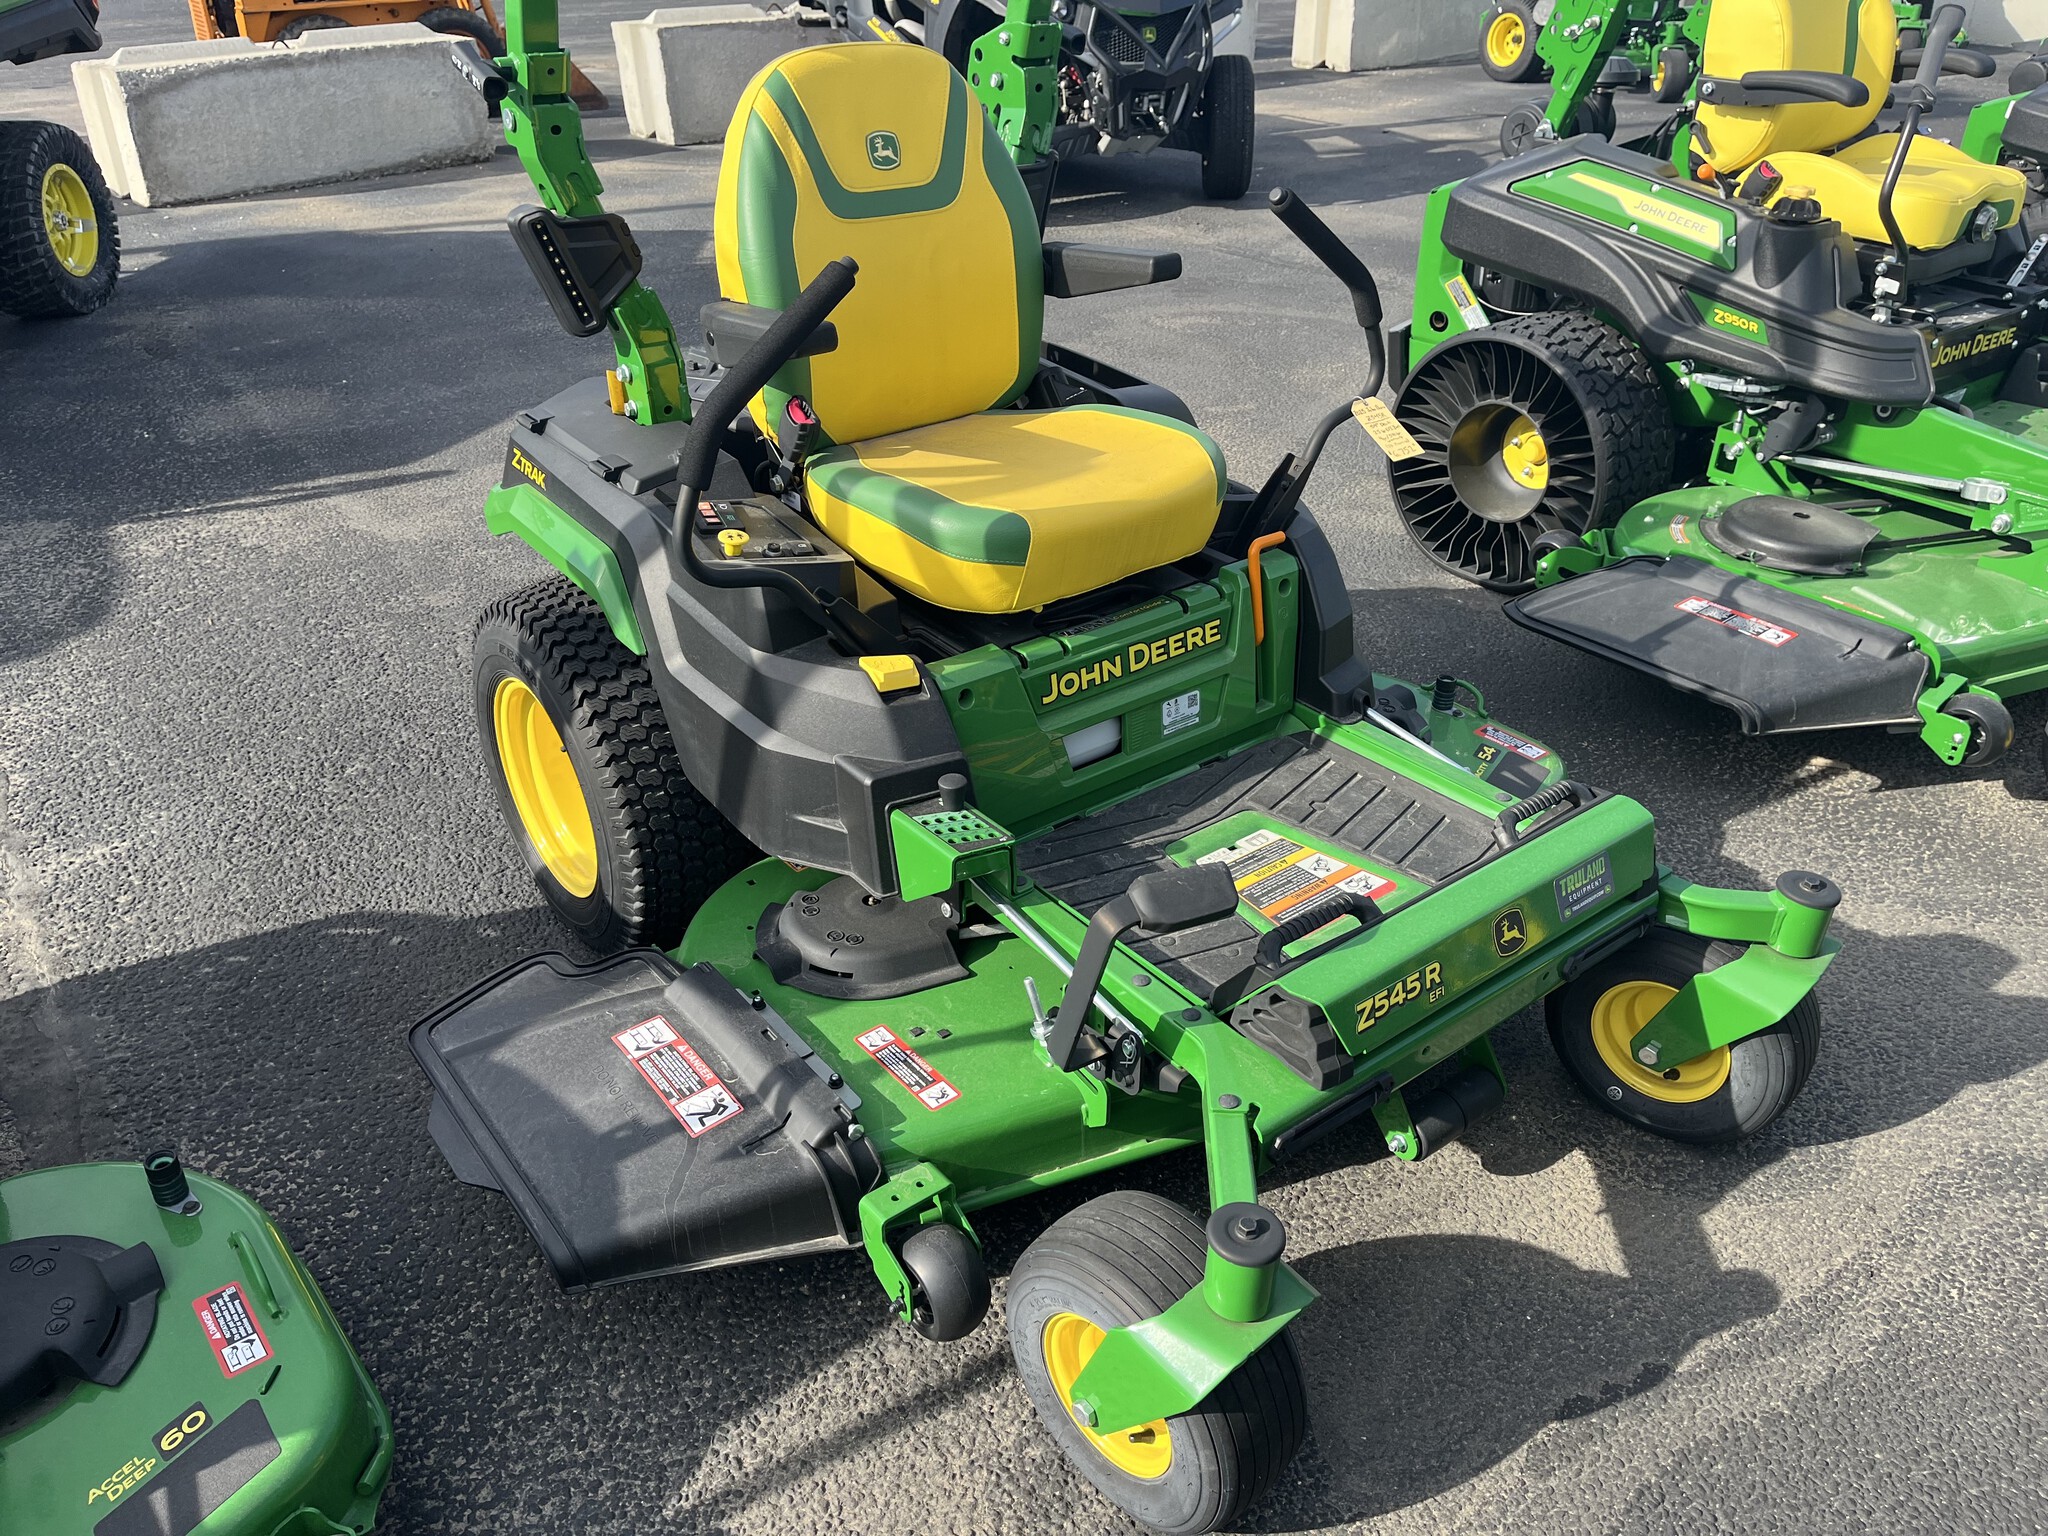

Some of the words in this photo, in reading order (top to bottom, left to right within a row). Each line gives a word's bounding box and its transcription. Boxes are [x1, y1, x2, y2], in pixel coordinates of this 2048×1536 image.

[1634, 200, 1666, 218] JOHN
[1667, 211, 1709, 234] DEERE
[1713, 308, 1759, 334] Z950R
[1931, 340, 1971, 368] JOHN
[1971, 327, 2017, 356] DEERE
[512, 448, 546, 490] ZTRAK
[1042, 655, 1122, 704] JOHN
[1129, 619, 1221, 672] DEERE
[1478, 745, 1497, 761] 54
[1255, 863, 1283, 878] CAUTION
[1559, 857, 1606, 897] TRULAND
[1291, 882, 1323, 900] WARNING
[1568, 878, 1602, 902] EQUIPMENT
[1429, 986, 1445, 1003] EFI
[684, 1051, 714, 1081] DANGER
[909, 1052, 934, 1073] DANGER
[592, 1065, 609, 1080] DO
[621, 1100, 660, 1146] REMOVE
[201, 1309, 216, 1335] DANGER
[160, 1410, 206, 1451] 60
[88, 1456, 146, 1505] ACCEL
[106, 1458, 156, 1502] DEEP
